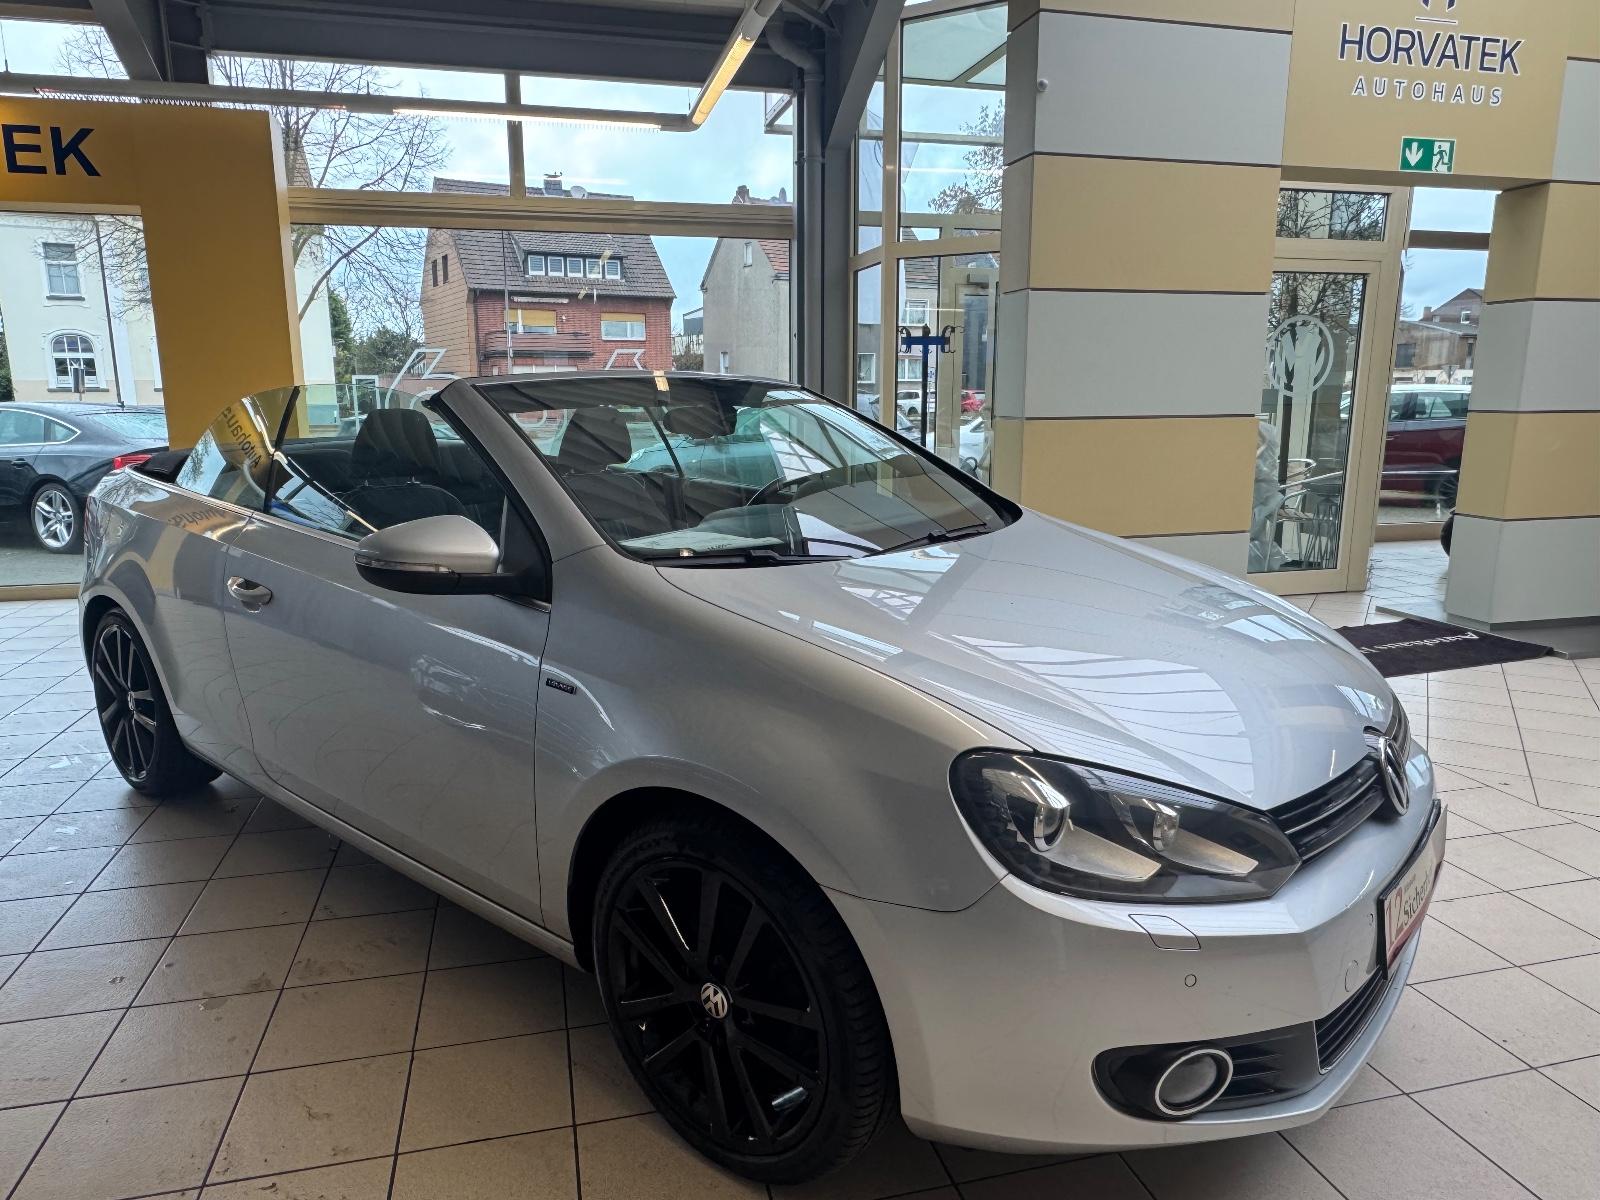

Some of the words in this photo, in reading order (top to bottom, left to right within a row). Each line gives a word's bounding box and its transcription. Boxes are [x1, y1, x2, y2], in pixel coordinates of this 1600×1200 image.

[1339, 23, 1523, 75] HORVATEK
[1353, 77, 1502, 105] AUTOHAUS
[1, 124, 101, 177] EK
